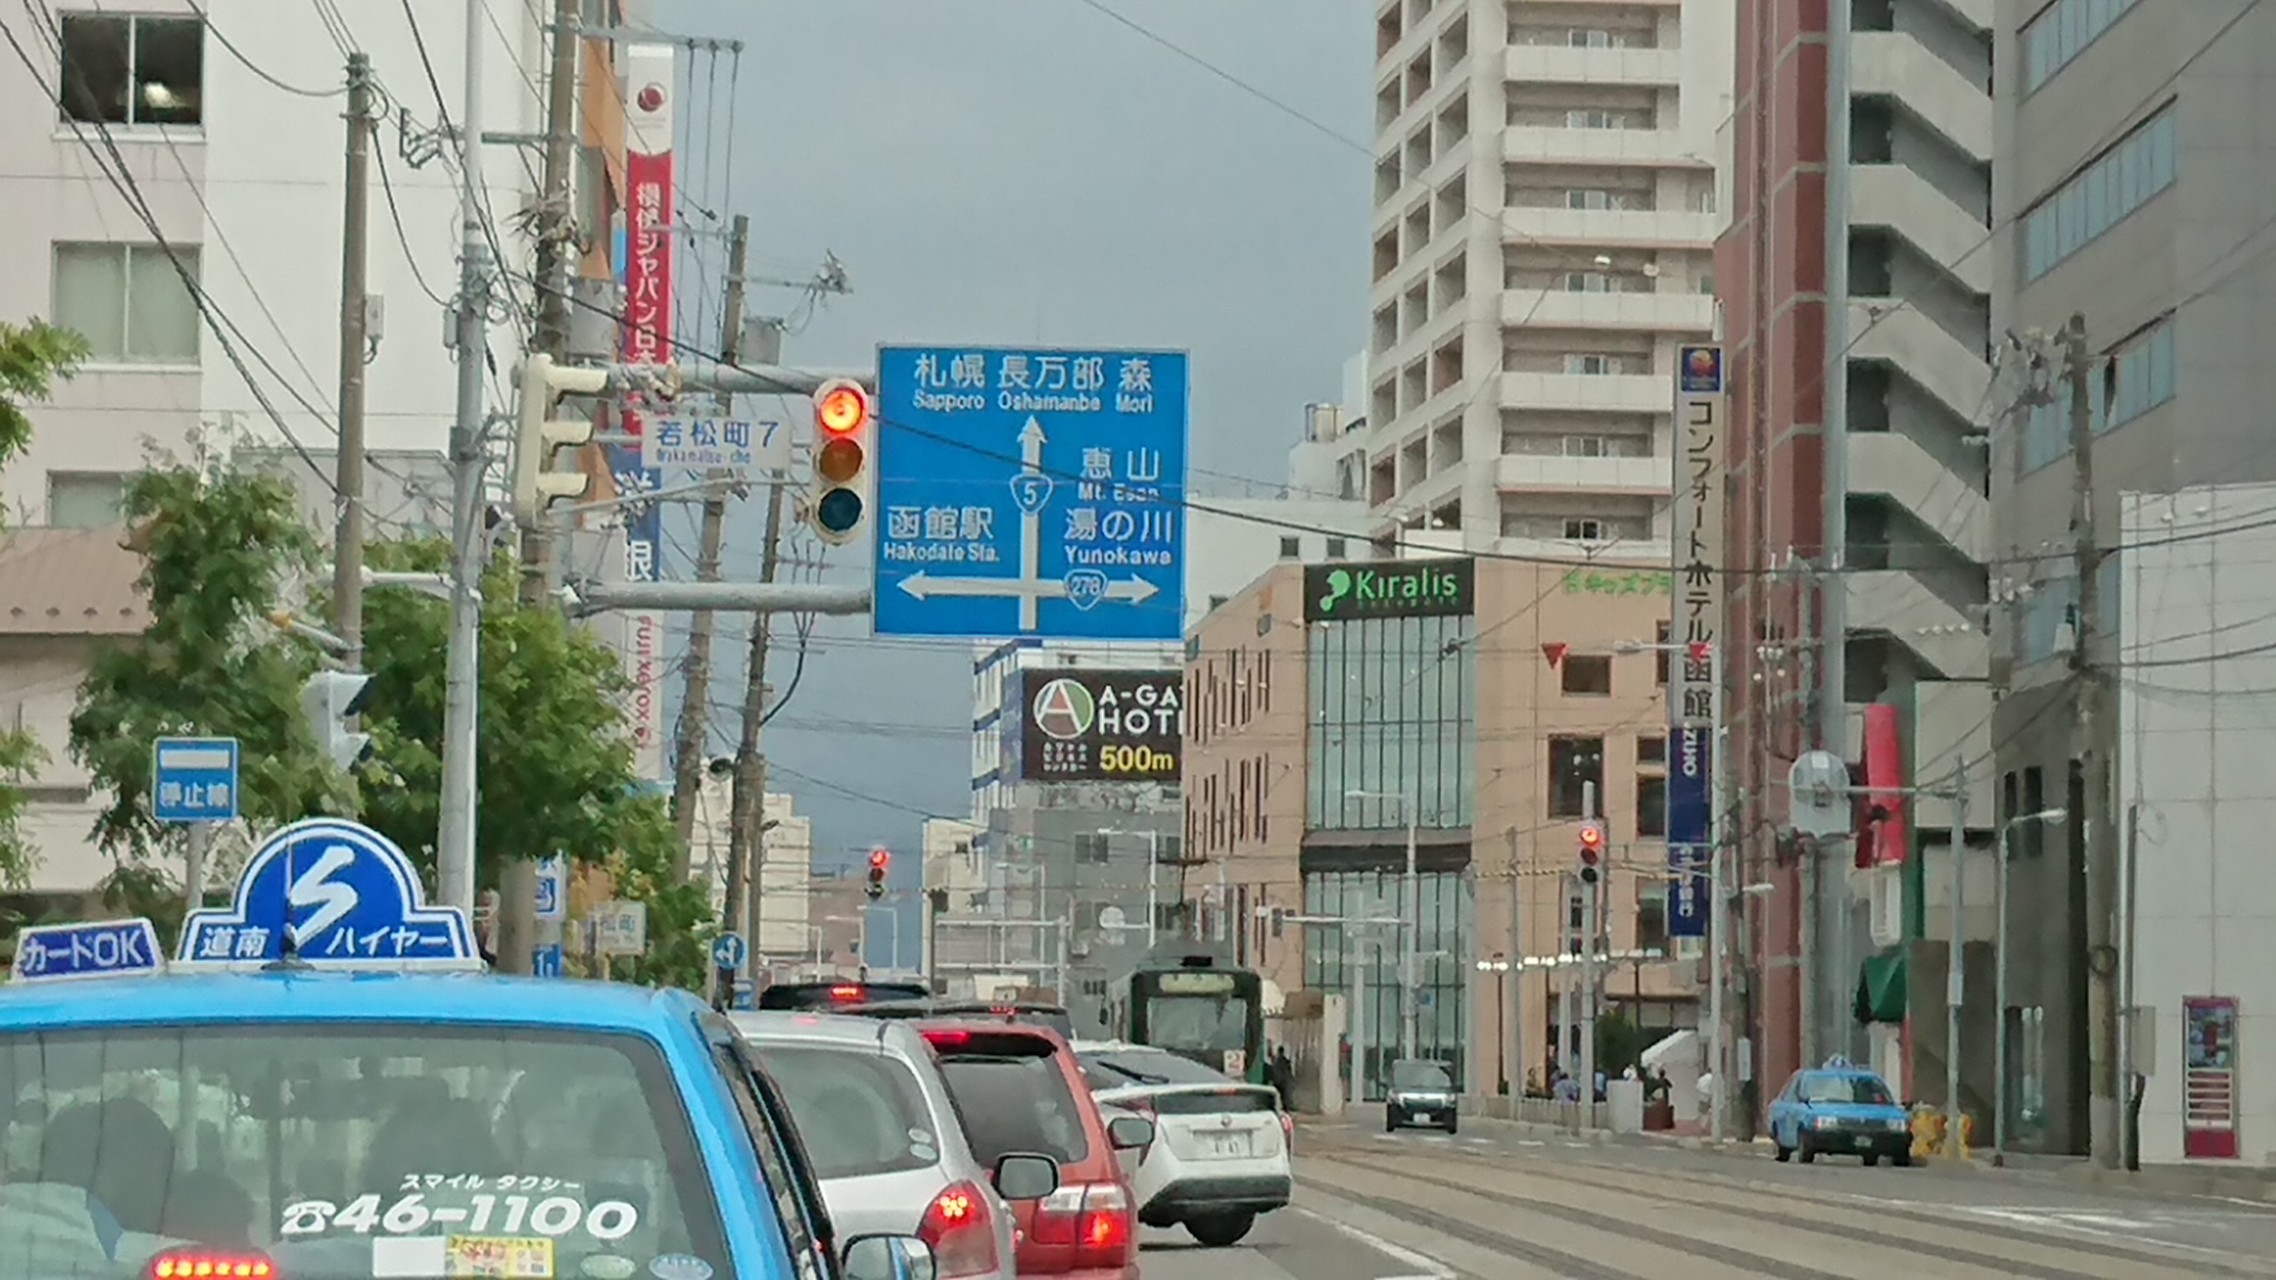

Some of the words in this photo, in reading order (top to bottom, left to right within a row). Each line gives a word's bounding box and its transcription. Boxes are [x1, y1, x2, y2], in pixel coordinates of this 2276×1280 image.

[914, 353, 986, 389] 札幌
[997, 355, 1105, 390] 長万部
[1117, 358, 1153, 392] 森
[913, 388, 986, 413] Sapporo
[998, 389, 1102, 412] Oshamanbe
[1115, 392, 1154, 413] Mori
[1081, 447, 1160, 481] 恵山
[1024, 483, 1037, 505] 5
[887, 505, 994, 541] 函館駅
[1063, 507, 1173, 544] 湯の川
[883, 541, 967, 562] Hakodate
[967, 543, 1000, 563] Sta.
[1064, 545, 1172, 567] Yunokawa
[1683, 401, 1714, 718] コンフォートホテル函館
[1071, 578, 1101, 597] 278
[1356, 567, 1458, 600] Kiralis
[1099, 684, 1183, 708] A-GA
[1100, 745, 1174, 772] 500m
[23, 929, 147, 972] カードOK
[203, 926, 271, 958] 道南
[326, 926, 449, 956] ハイヤー
[399, 1173, 485, 1191] スマイル
[497, 1175, 580, 1190] タクシー
[333, 1193, 638, 1239] 46-1100
